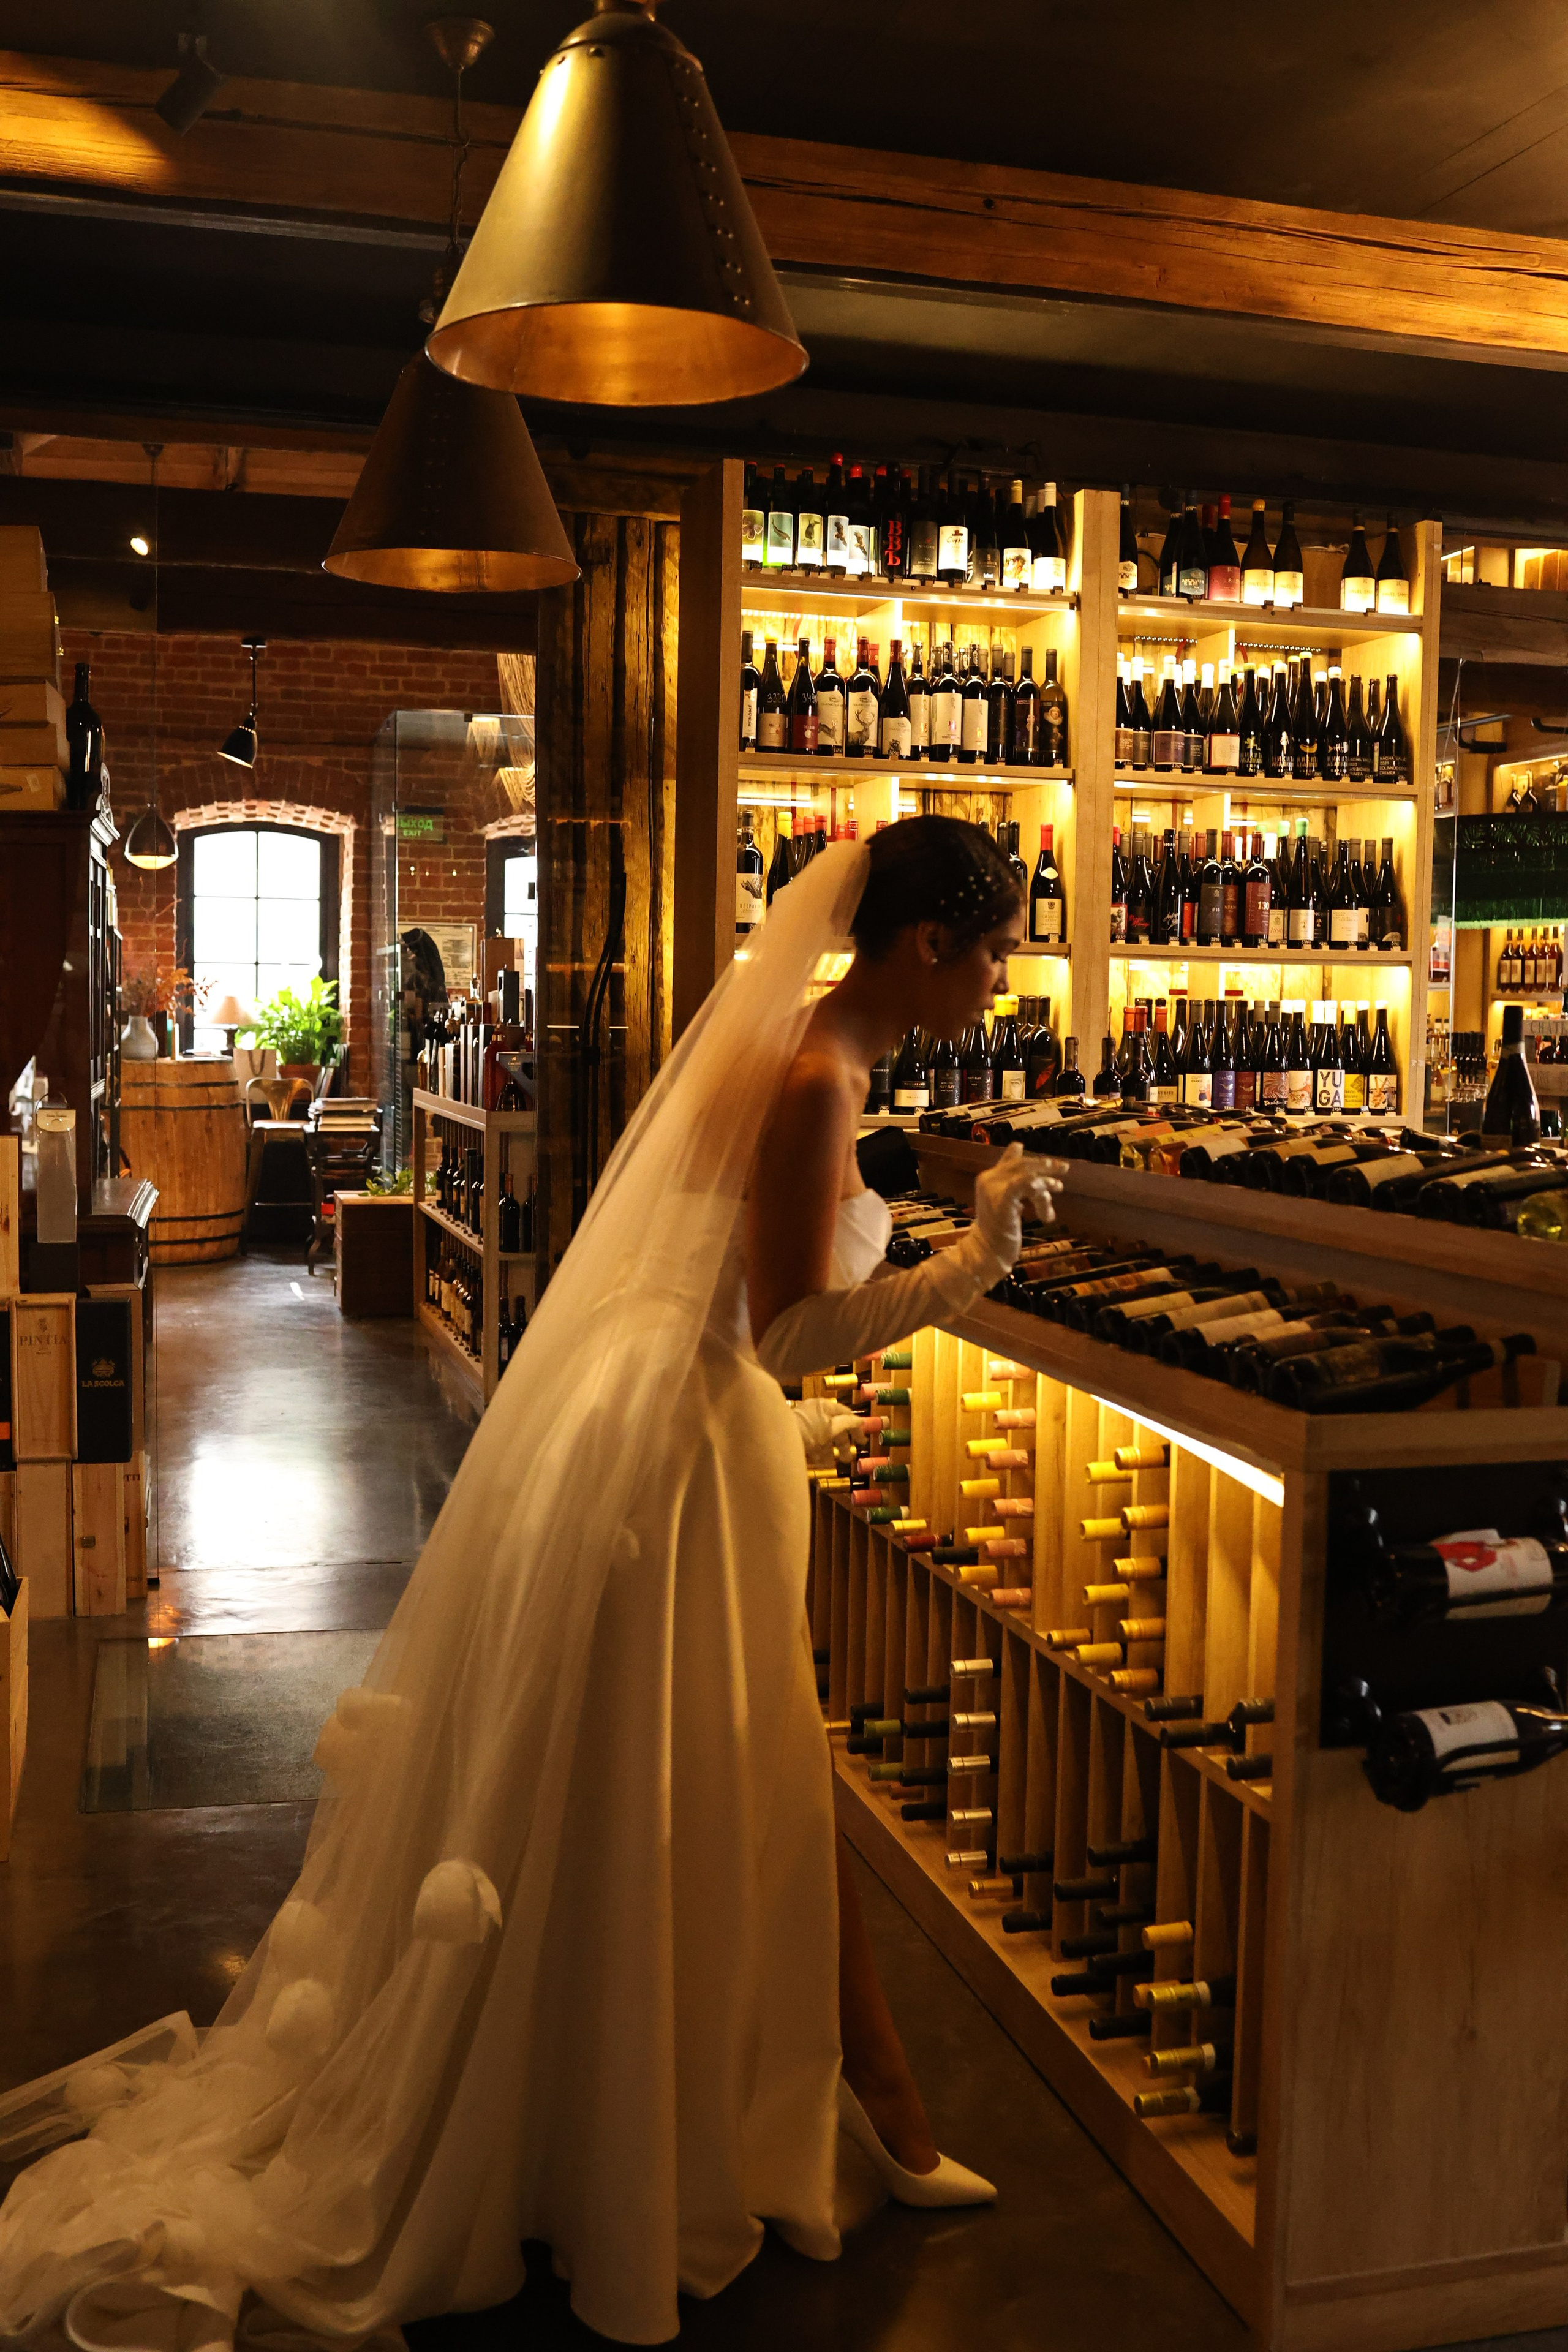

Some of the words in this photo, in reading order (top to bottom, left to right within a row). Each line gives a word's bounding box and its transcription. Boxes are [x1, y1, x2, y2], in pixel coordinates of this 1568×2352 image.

[1257, 901, 1270, 910] 130
[1319, 1071, 1343, 1088] YU
[1319, 1090, 1342, 1106] GA
[20, 1335, 67, 1346] PINTIA
